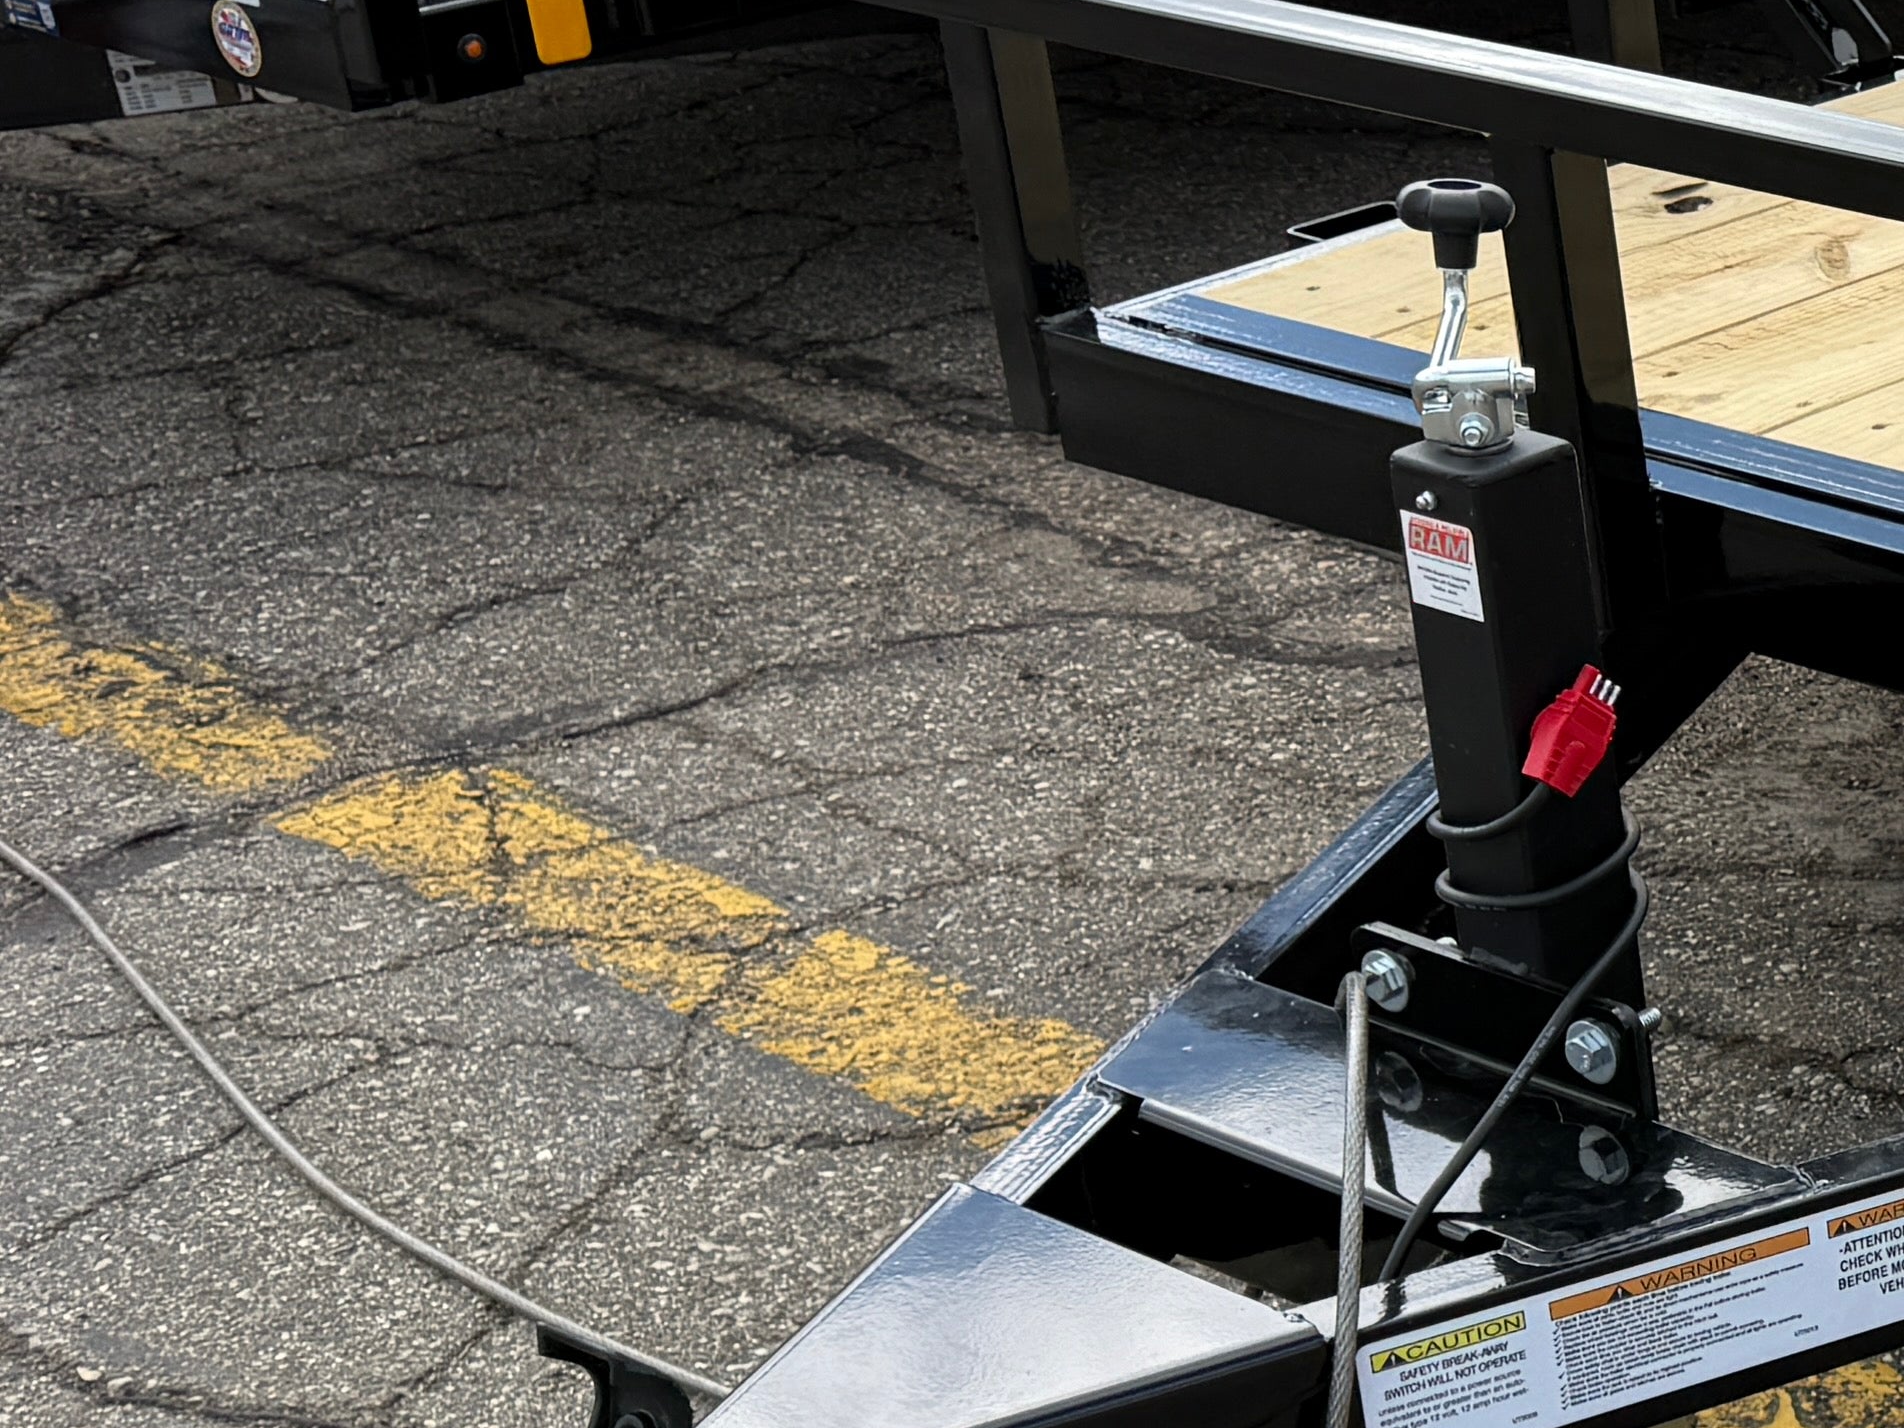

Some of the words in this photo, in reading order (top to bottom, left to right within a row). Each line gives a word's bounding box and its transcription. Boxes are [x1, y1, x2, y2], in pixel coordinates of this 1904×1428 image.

[1411, 526, 1468, 561] RAM
[1640, 1248, 1757, 1291] WARNING
[1838, 1265, 1888, 1291] BEFORE
[1840, 1249, 1883, 1272] CHECK
[1406, 1315, 1521, 1360] CAUTION
[1384, 1378, 1426, 1401] SWITCH
[1427, 1373, 1453, 1389] WILL
[1455, 1365, 1477, 1384] NOT
[1478, 1350, 1527, 1373] OPERATE
[1400, 1360, 1440, 1382] SAFETY
[1442, 1341, 1509, 1370] BREAK-AWAY
